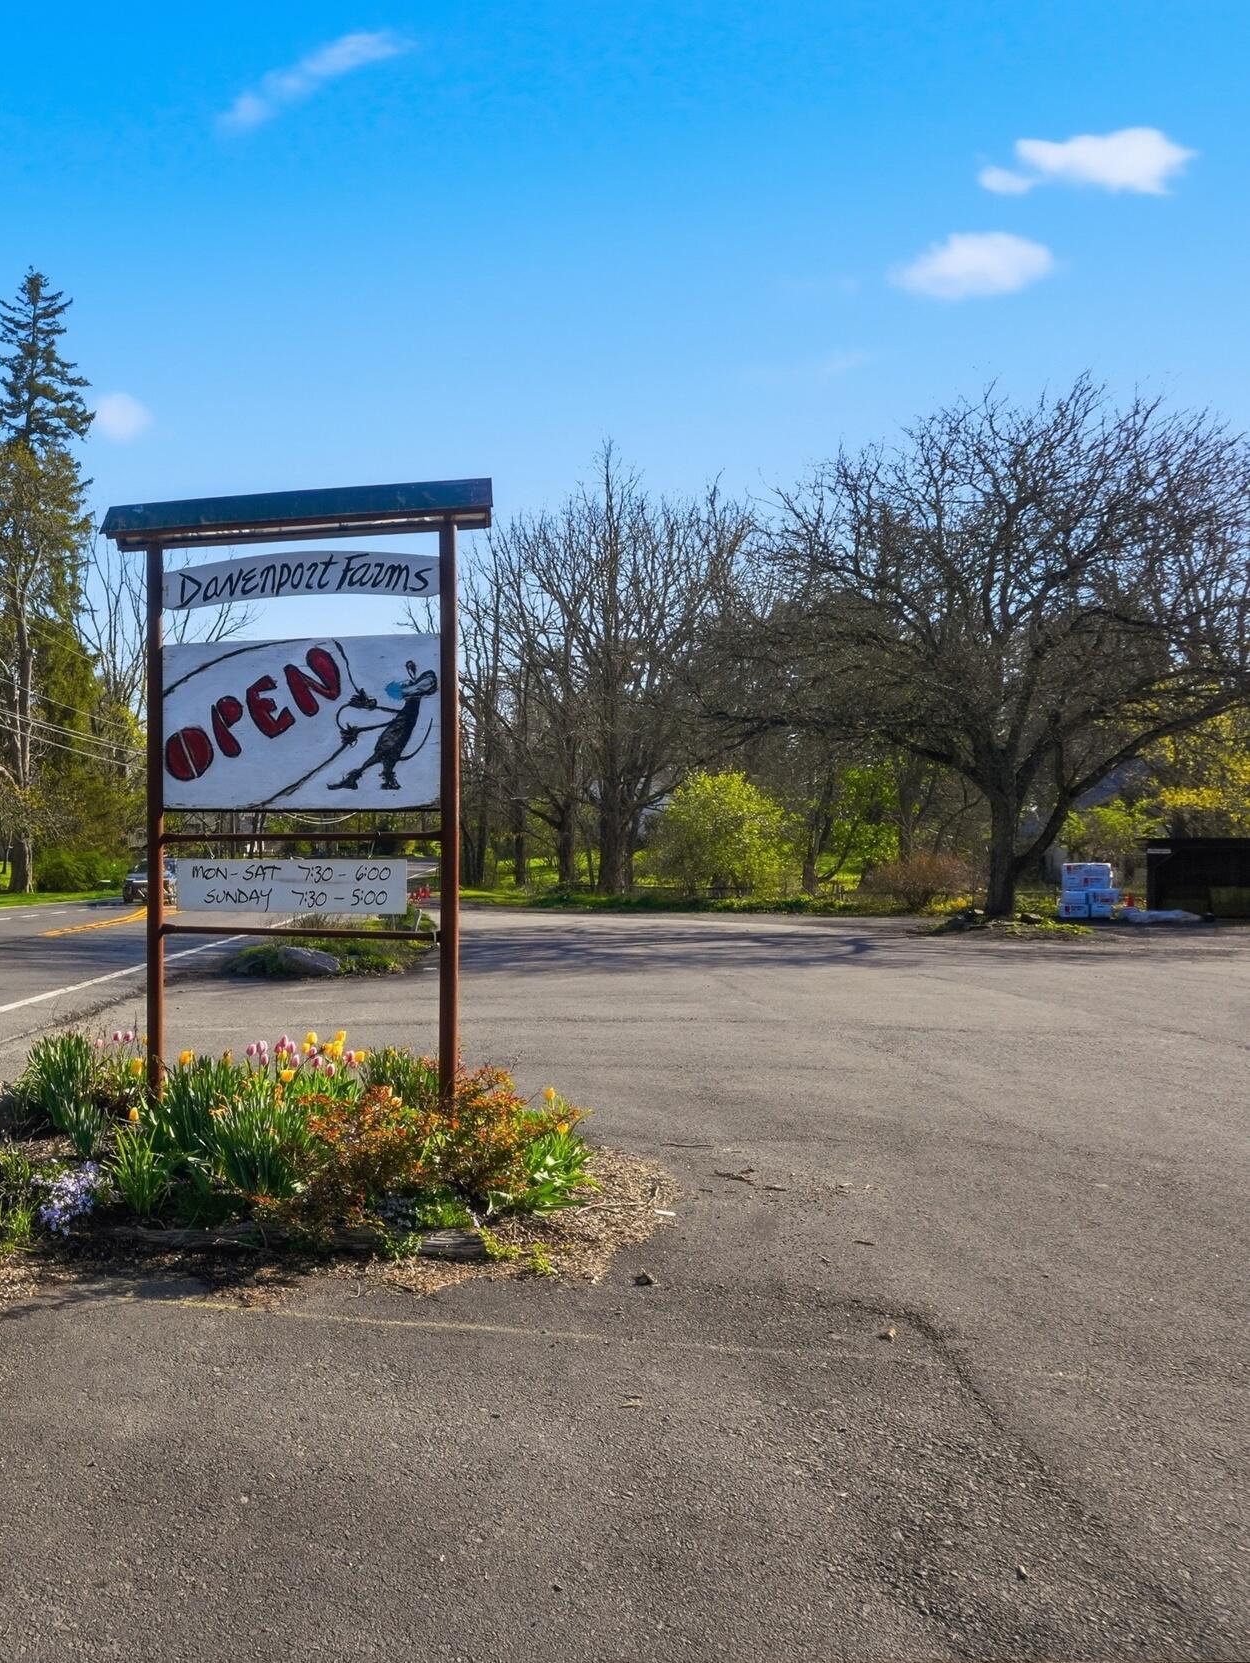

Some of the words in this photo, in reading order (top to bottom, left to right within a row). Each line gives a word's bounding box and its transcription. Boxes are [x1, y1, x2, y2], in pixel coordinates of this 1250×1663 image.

[336, 553, 432, 592] Farms
[165, 647, 341, 781] OPEN
[298, 865, 334, 883] 7:30
[355, 865, 391, 882] 6:00
[204, 887, 273, 912] SUNDAY
[291, 890, 327, 908] 7:30
[350, 888, 388, 907] 5:00
